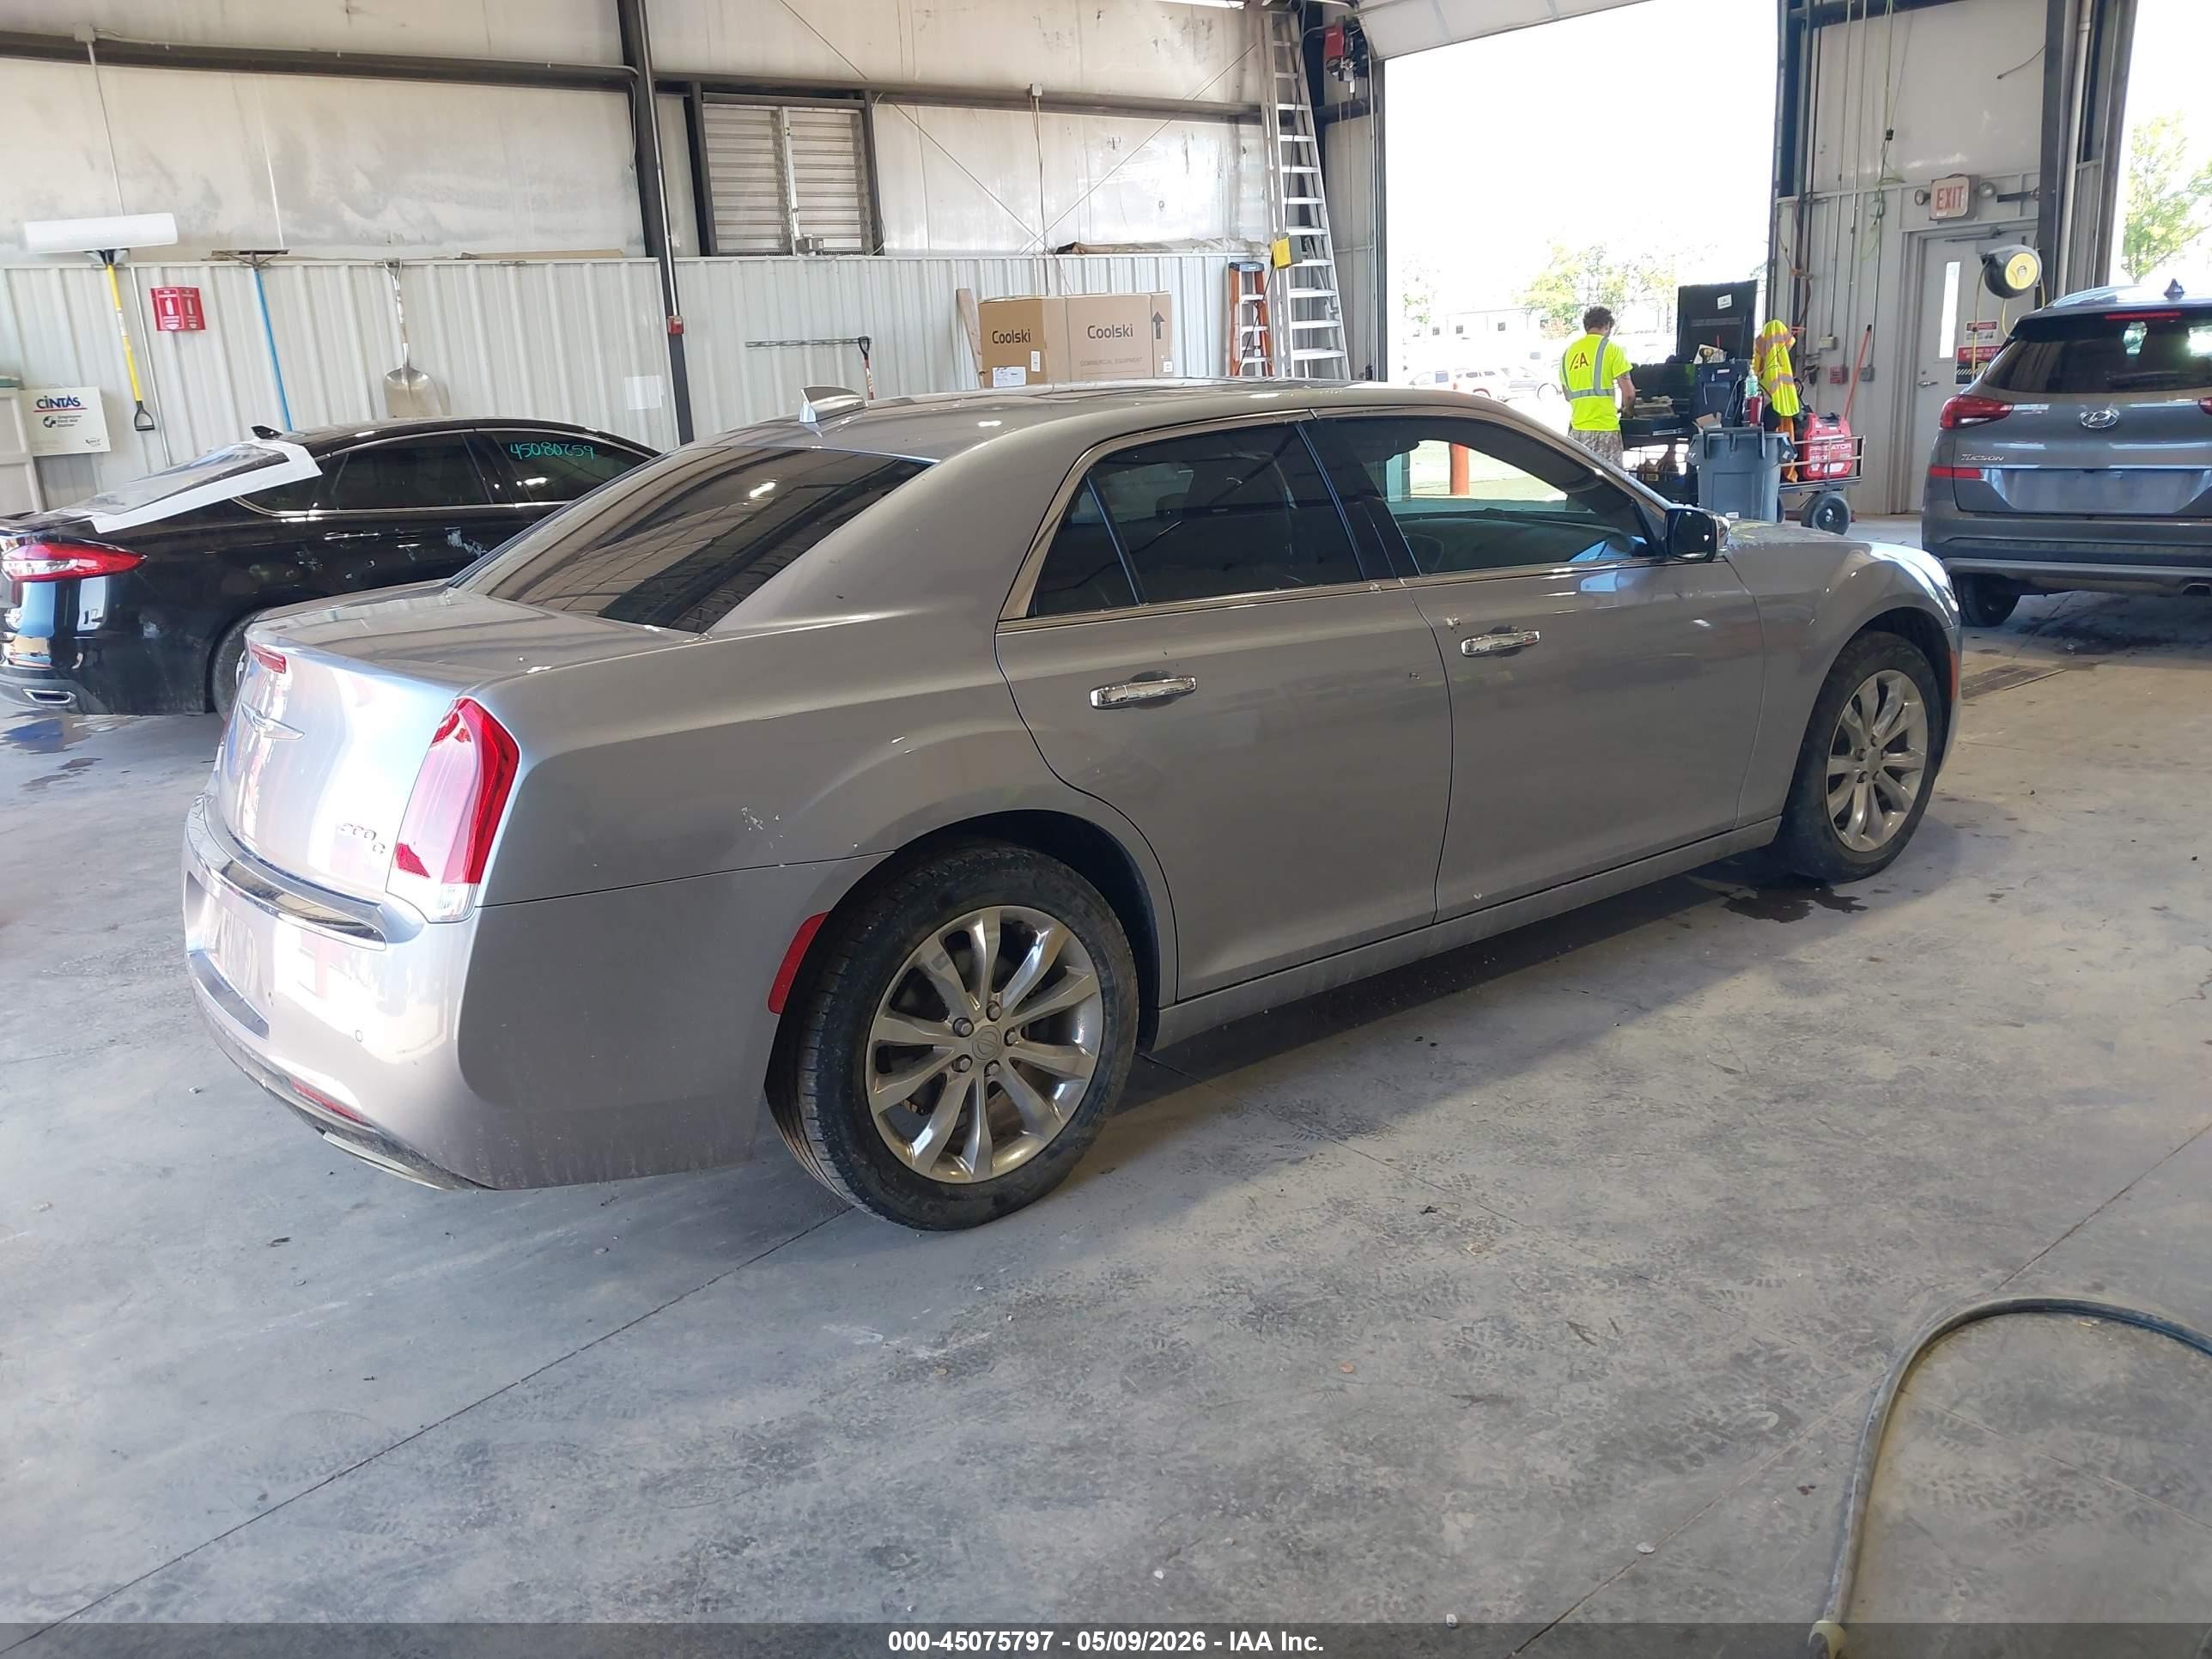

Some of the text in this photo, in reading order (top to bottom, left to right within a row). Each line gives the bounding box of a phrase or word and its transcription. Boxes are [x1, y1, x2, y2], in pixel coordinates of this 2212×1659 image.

[1936, 185, 1965, 210] EXIT
[992, 330, 1031, 344] Coolski
[1087, 324, 1133, 339] Coolski
[1079, 356, 1144, 368] COMMERCIAL EQUIPMENT
